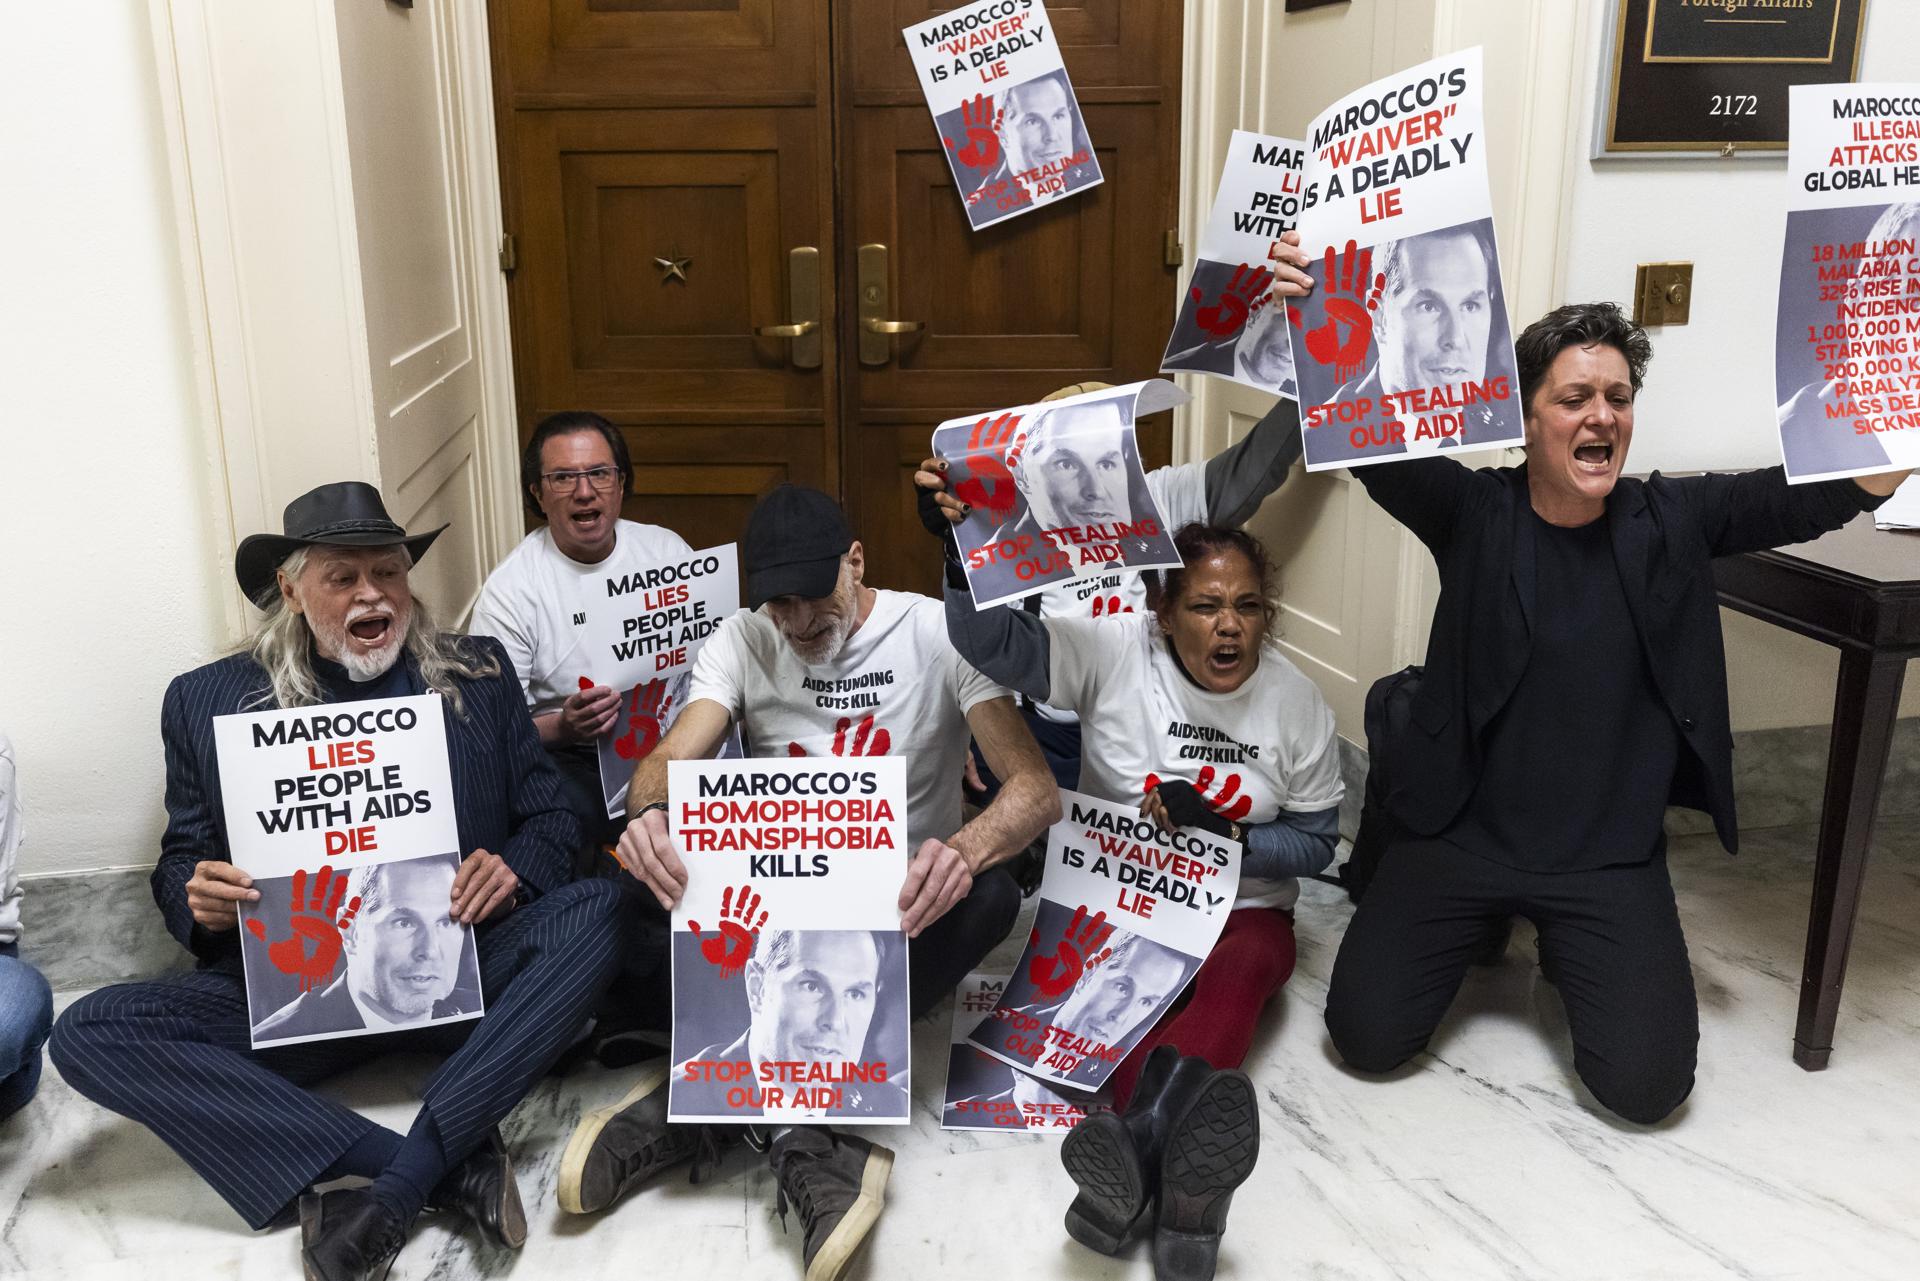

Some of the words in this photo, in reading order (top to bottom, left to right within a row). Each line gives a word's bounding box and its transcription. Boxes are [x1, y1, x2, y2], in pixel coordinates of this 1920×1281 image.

[920, 0, 1033, 47] MAROCCO'S
[938, 12, 1030, 56] "WAIVER"
[930, 64, 948, 83] IS
[954, 58, 968, 75] A
[969, 26, 1044, 68] DEADLY
[979, 61, 1009, 83] LIE
[1312, 67, 1467, 153] MAROCCO'S
[1709, 95, 1758, 115] 2172
[1319, 103, 1457, 170] "WAIVER"
[1829, 143, 1918, 167] ATTACKS
[967, 181, 1008, 205] STOP
[1011, 150, 1090, 186] STEALING
[1301, 183, 1318, 212] IS
[1324, 174, 1344, 203] A
[1352, 132, 1474, 195] DEADLY
[1804, 168, 1887, 192] GLOBAL
[996, 189, 1032, 212] OUR
[1036, 177, 1067, 198] AID!
[1359, 187, 1403, 225] LIE
[1812, 244, 1834, 263] 18
[1839, 239, 1915, 260] MILLION
[1818, 260, 1901, 282] MALARIA
[1819, 283, 1859, 301] 32%
[1863, 280, 1902, 297] RISE
[1808, 319, 1900, 343] 1,000,000
[1816, 338, 1907, 362] STARVING
[1824, 358, 1902, 380] 200,000
[1307, 398, 1372, 429] STOP
[1380, 376, 1510, 417] STEALING
[1825, 398, 1883, 419] MASS
[1349, 421, 1405, 449] OUR
[1414, 412, 1467, 441] AID!
[967, 534, 1034, 569] STOP
[1040, 518, 1159, 548] STEALING
[606, 555, 719, 597] MAROCCO
[1015, 552, 1072, 581] OUR
[1080, 542, 1127, 566] AID!
[643, 584, 690, 611] LIES
[1101, 575, 1121, 589] KILL
[622, 600, 706, 639] PEOPLE
[611, 630, 673, 662] WITH
[655, 647, 687, 672] DIE
[802, 676, 834, 693] AIDS
[836, 670, 894, 693] FUNDING
[816, 695, 849, 710] CUTS
[851, 692, 880, 709] KILL
[252, 707, 417, 748] MAROCCO
[1168, 721, 1199, 740] AIDS
[307, 740, 376, 771] LIES
[1180, 744, 1213, 762] CUTS
[1214, 748, 1245, 764] KILL
[274, 764, 403, 804] PEOPLE
[698, 772, 877, 797] MAROCCO'S
[255, 800, 352, 834] WITH
[362, 789, 432, 822] AIDS
[682, 799, 895, 825] HOMOPHOBIA
[324, 825, 378, 856] DIE
[679, 826, 895, 852] TRANSPHOBIA
[1070, 803, 1229, 867] MAROCCO'S
[750, 854, 829, 878] KILLS
[1085, 830, 1220, 884] "WAIVER"
[1062, 846, 1085, 868] IS
[1090, 856, 1110, 878] A
[1117, 862, 1226, 915] DEADLY
[1117, 887, 1157, 920] LIE
[1004, 1034, 1046, 1061] OUR
[1043, 1051, 1083, 1073] AID!
[1041, 1024, 1126, 1063] STEALING
[684, 1061, 752, 1083] STOP
[759, 1061, 888, 1083] STEALING
[726, 1088, 784, 1109] OUR
[790, 1087, 843, 1109] AID!
[955, 1102, 1016, 1113] STOP
[993, 1114, 1045, 1127] OUR
